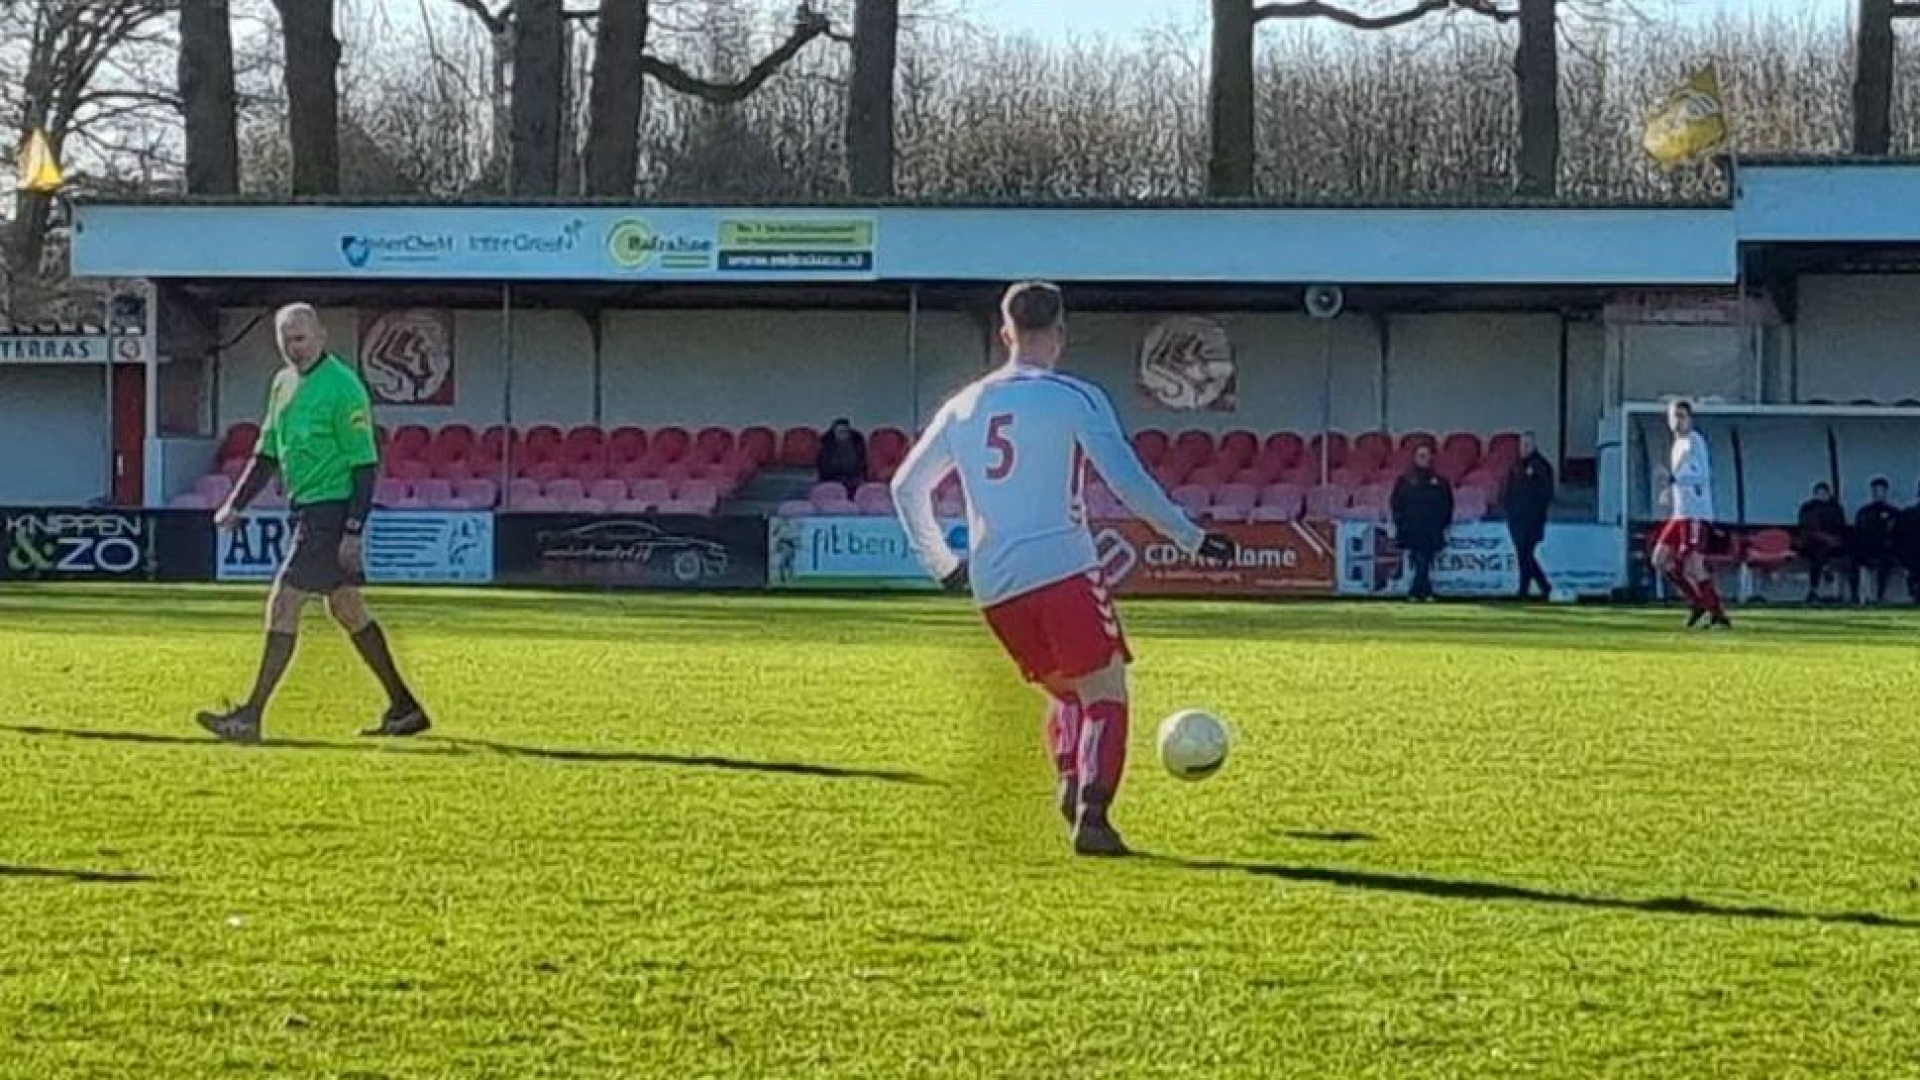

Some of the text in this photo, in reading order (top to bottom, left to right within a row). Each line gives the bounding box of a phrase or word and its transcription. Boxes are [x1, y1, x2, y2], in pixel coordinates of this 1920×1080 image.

[0, 340, 90, 359] TERRAS
[985, 413, 1016, 480] 5
[6, 514, 142, 536] KNIPPEN
[7, 524, 54, 571] &
[56, 537, 140, 572] ZO
[811, 523, 843, 571] fit
[847, 531, 895, 556] ben
